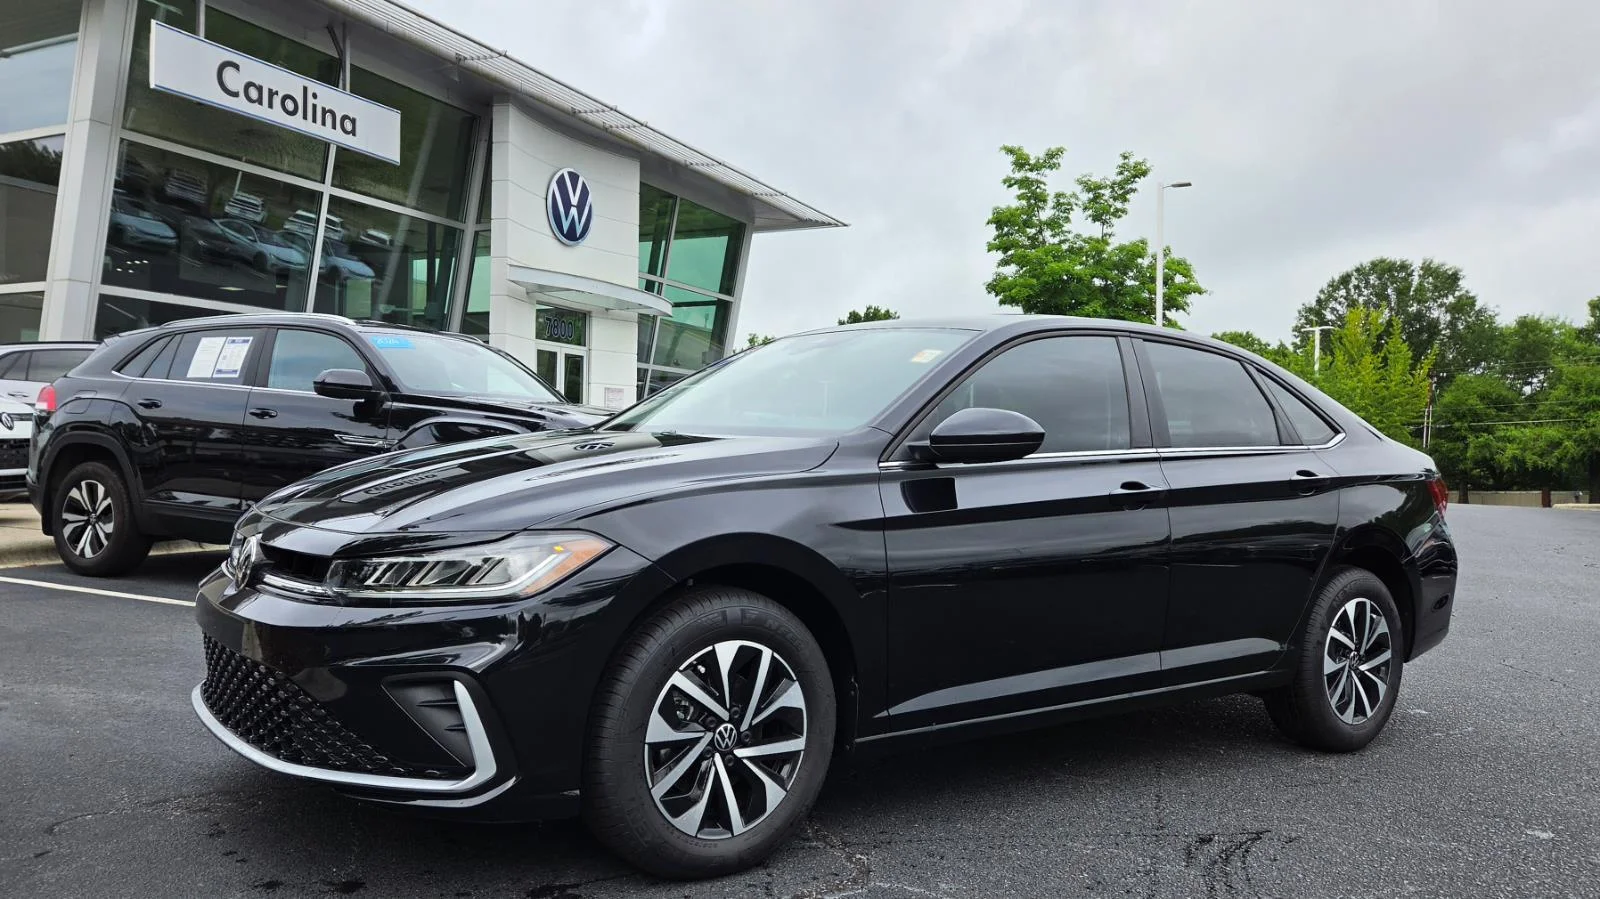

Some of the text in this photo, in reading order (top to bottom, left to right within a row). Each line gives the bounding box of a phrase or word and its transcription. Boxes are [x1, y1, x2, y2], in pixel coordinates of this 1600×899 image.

[216, 60, 358, 137] Carolina
[548, 169, 592, 244] VW
[545, 315, 574, 340] 7800
[714, 723, 737, 750] VW
